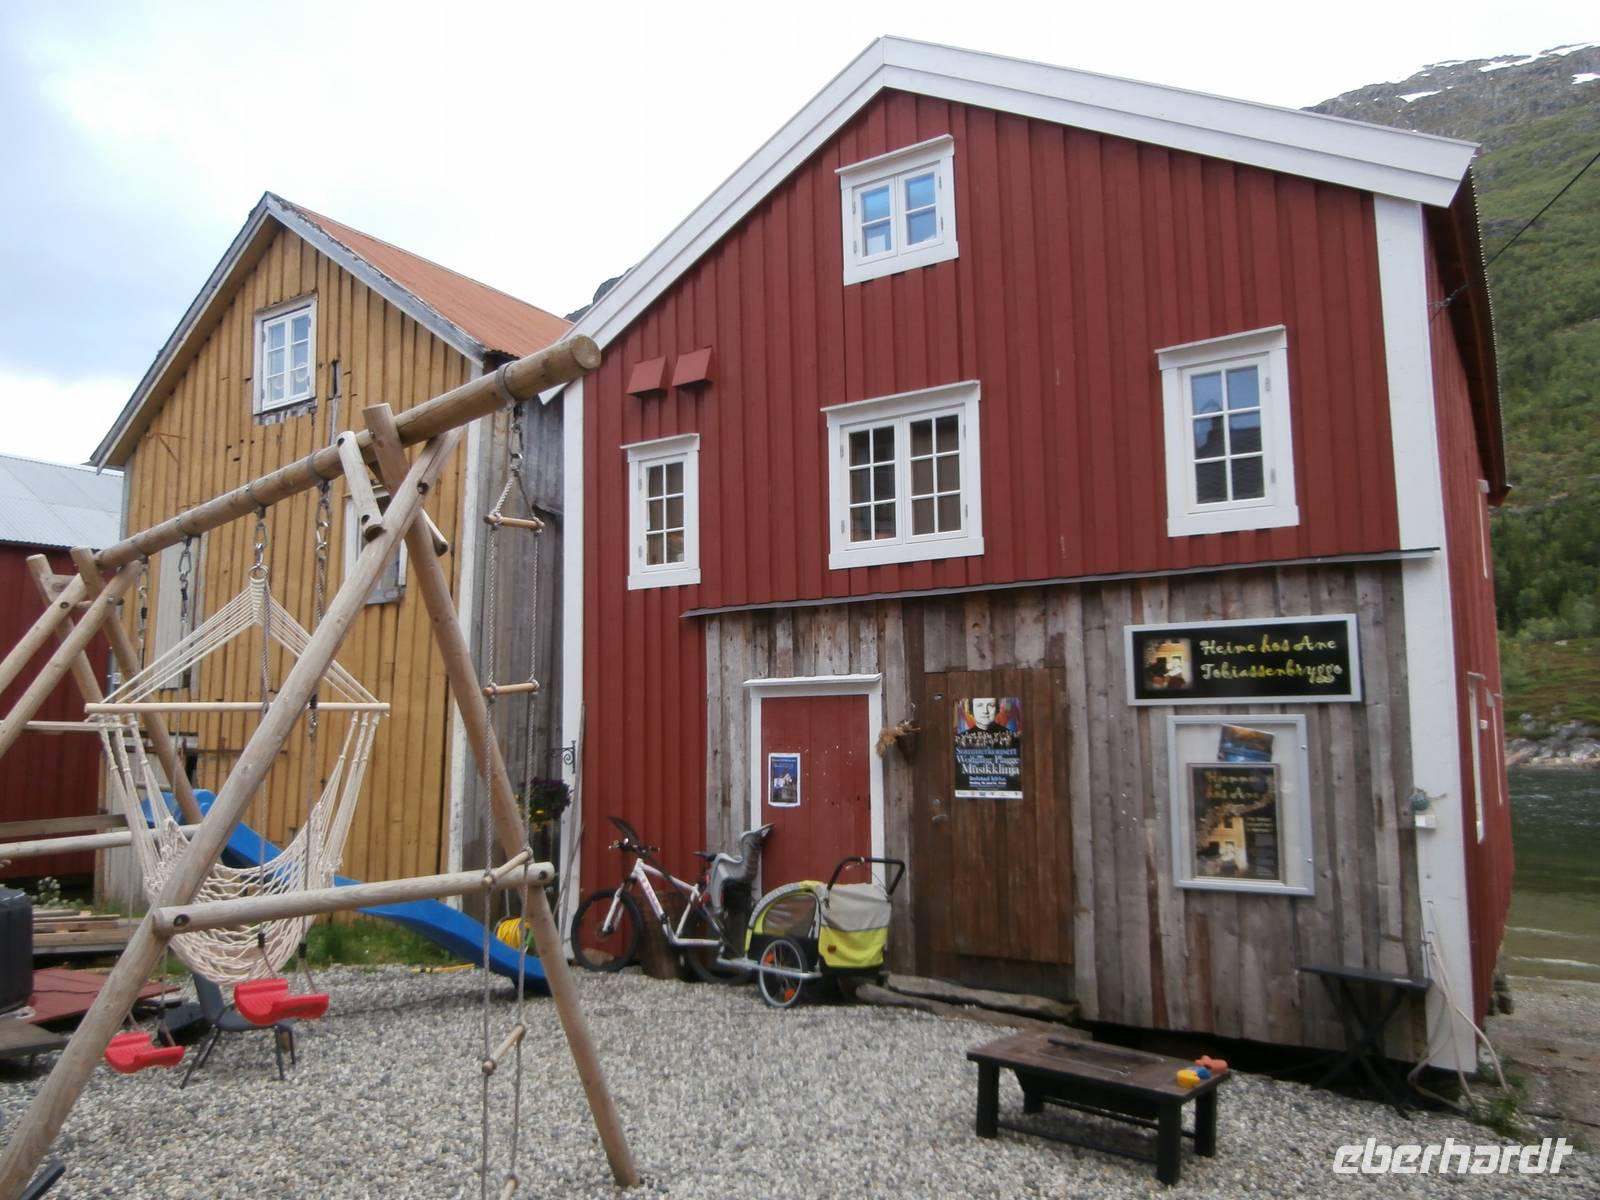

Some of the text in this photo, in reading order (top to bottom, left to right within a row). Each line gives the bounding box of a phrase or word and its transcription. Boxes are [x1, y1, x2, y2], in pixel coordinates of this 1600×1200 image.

[1260, 634, 1290, 653] hos
[1293, 635, 1337, 651] Ane
[962, 763, 1020, 776] Musikklinja
